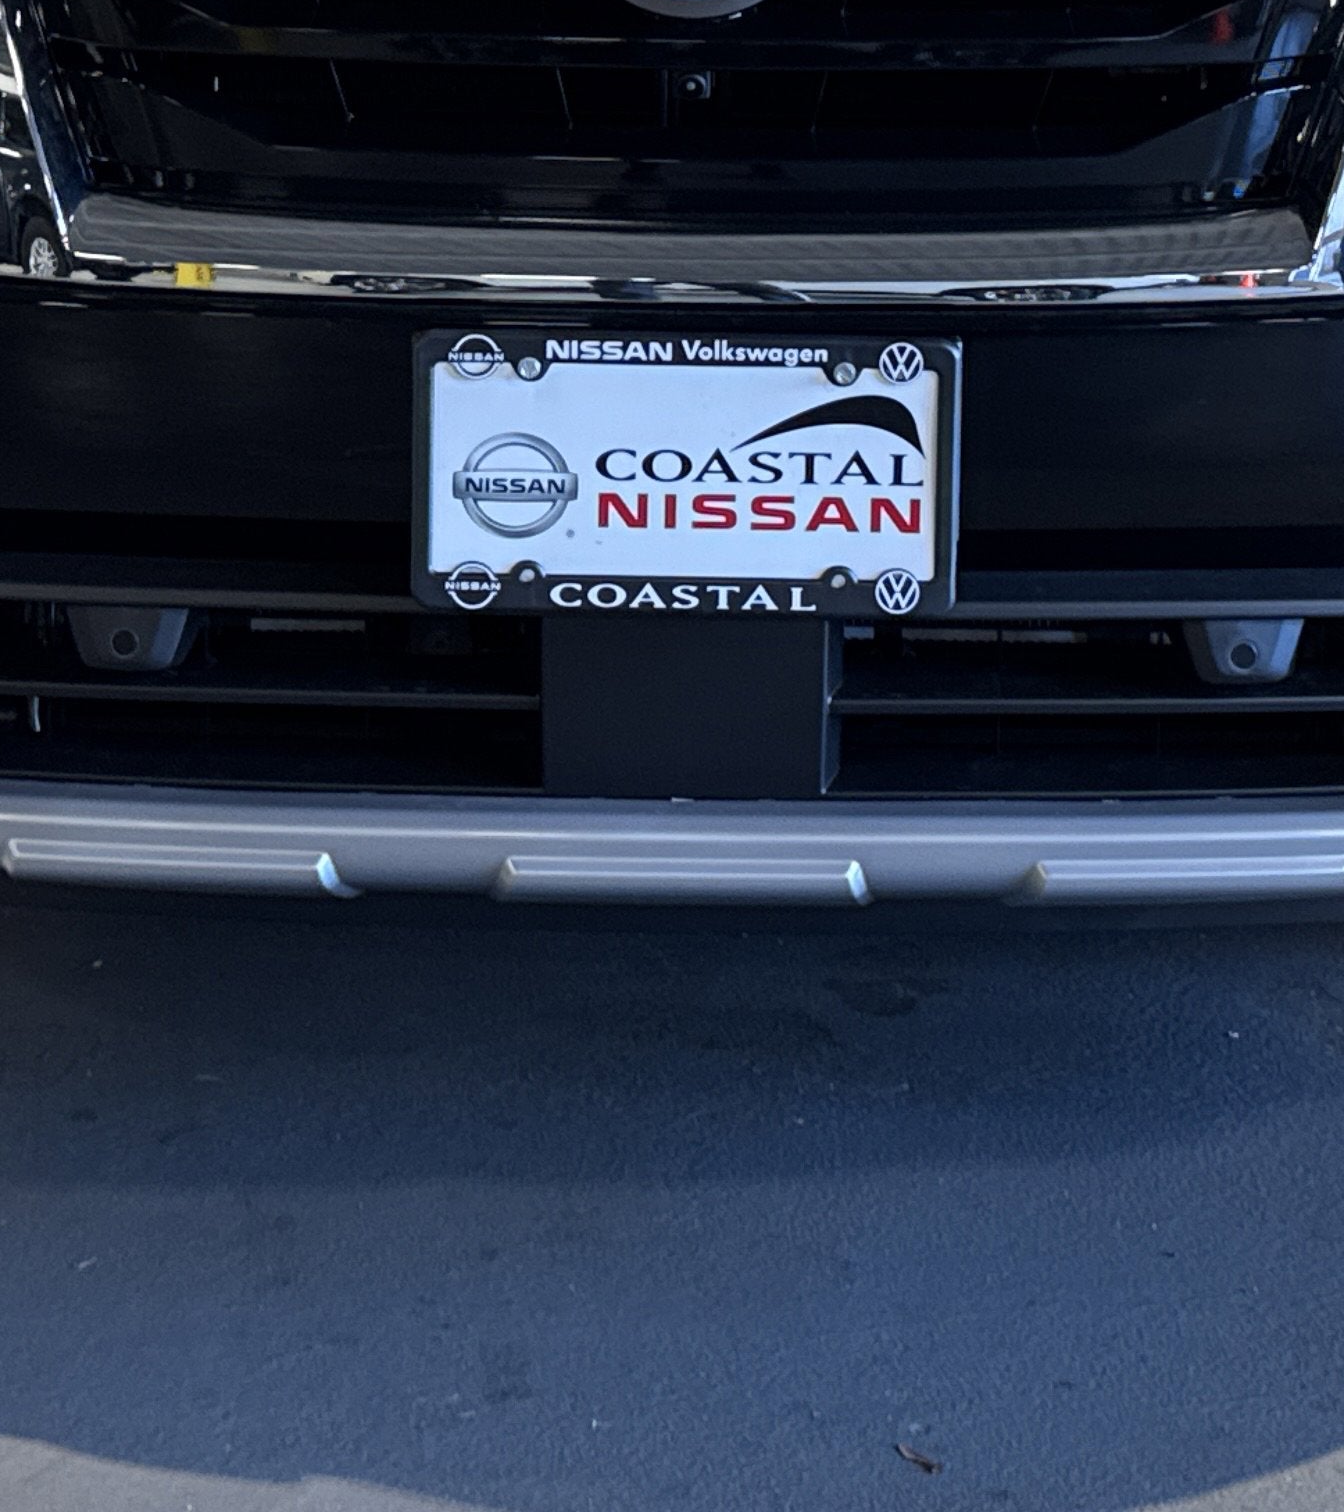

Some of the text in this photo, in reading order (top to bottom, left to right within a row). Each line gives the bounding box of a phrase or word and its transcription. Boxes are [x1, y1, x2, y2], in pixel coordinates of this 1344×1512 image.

[545, 339, 830, 367] NISSAN Volkswagen
[595, 447, 926, 487] COASTAL
[464, 475, 567, 496] NISSAN
[596, 492, 923, 535] NISSAN
[549, 581, 818, 613] COASTAL
